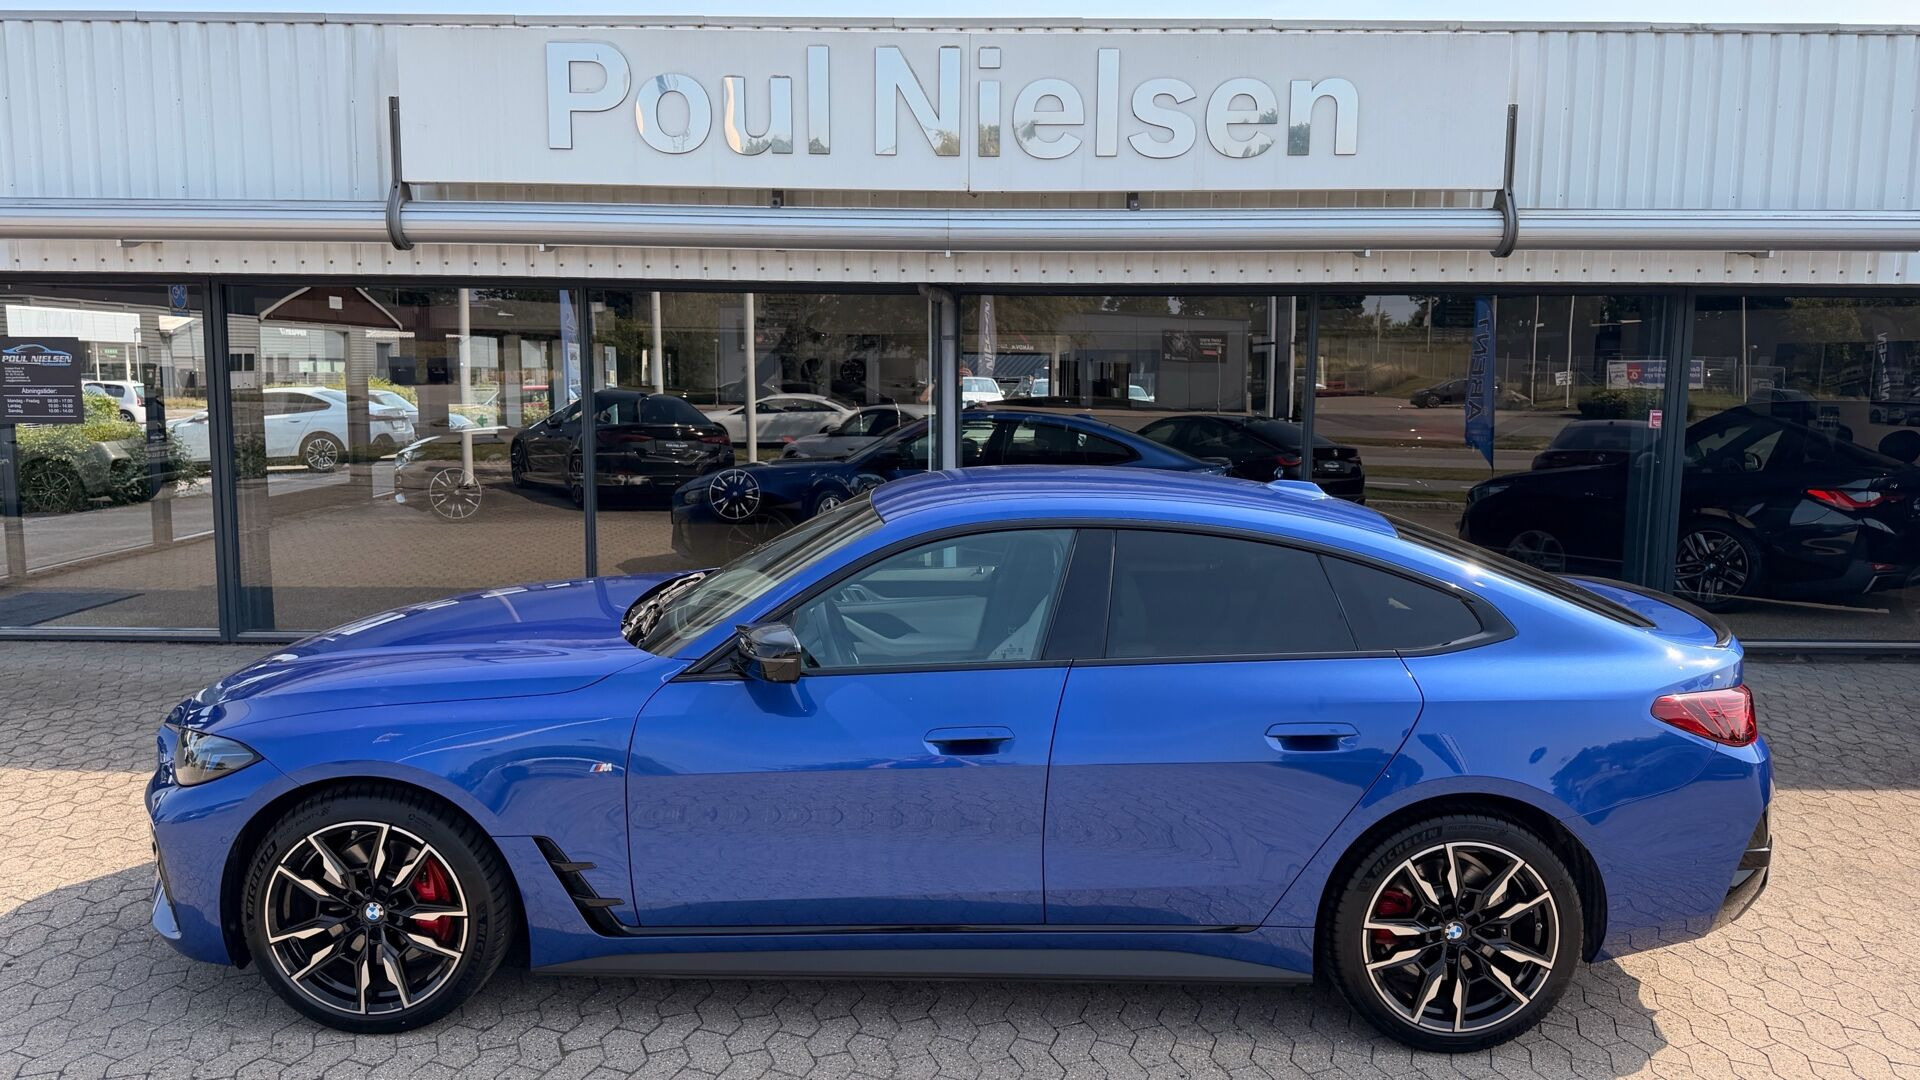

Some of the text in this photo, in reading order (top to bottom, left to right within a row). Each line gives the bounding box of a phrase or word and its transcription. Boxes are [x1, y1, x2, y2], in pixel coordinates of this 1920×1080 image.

[546, 41, 1359, 160] Poul Nielsen
[2, 355, 72, 363] POUL NIELSEN
[21, 388, 58, 396] Åbningstider:
[1372, 829, 1439, 876] MICHELIN
[246, 843, 277, 915] MICHELIN
